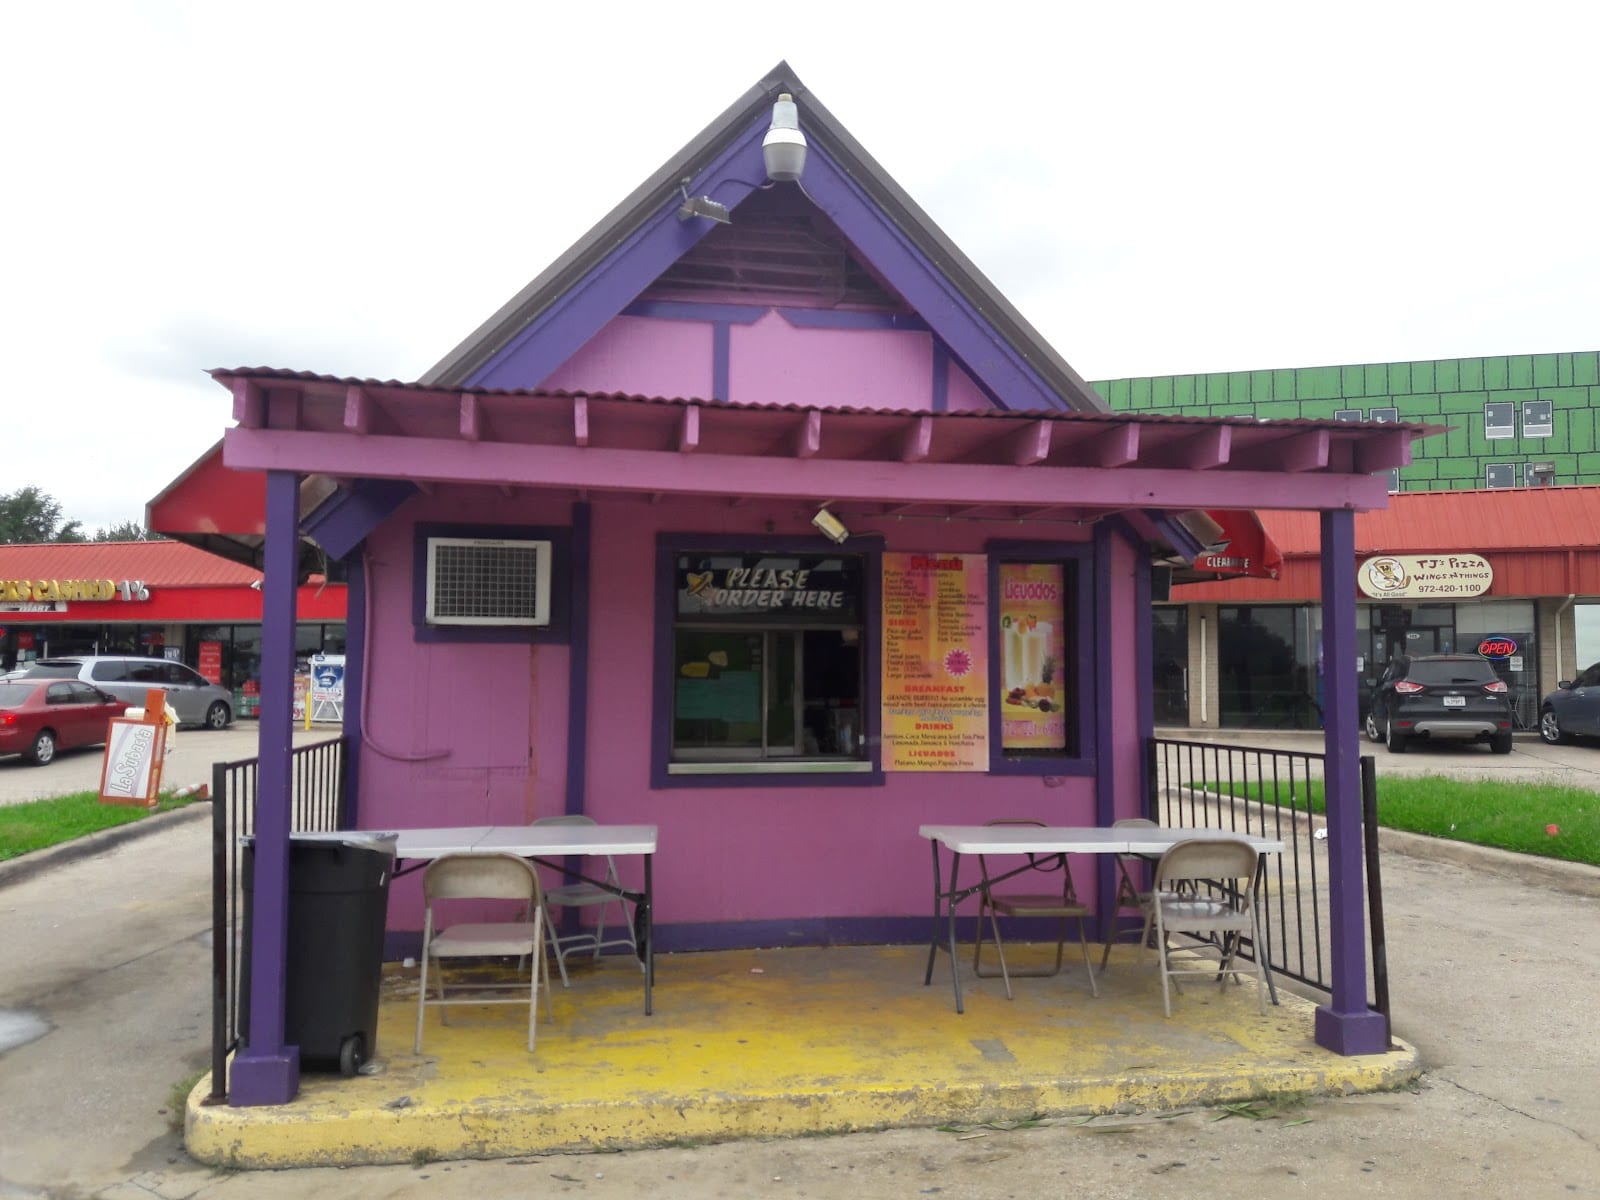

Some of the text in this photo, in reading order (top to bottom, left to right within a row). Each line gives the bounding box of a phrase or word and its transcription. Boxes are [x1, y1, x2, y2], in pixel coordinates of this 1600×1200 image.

[727, 567, 810, 589] PLEASE
[32, 579, 115, 601] CASHED
[117, 579, 150, 601] 1%
[1419, 584, 1481, 593] 972-420-1100
[715, 589, 844, 608] ORDER HERE
[1480, 641, 1513, 655] OPEN
